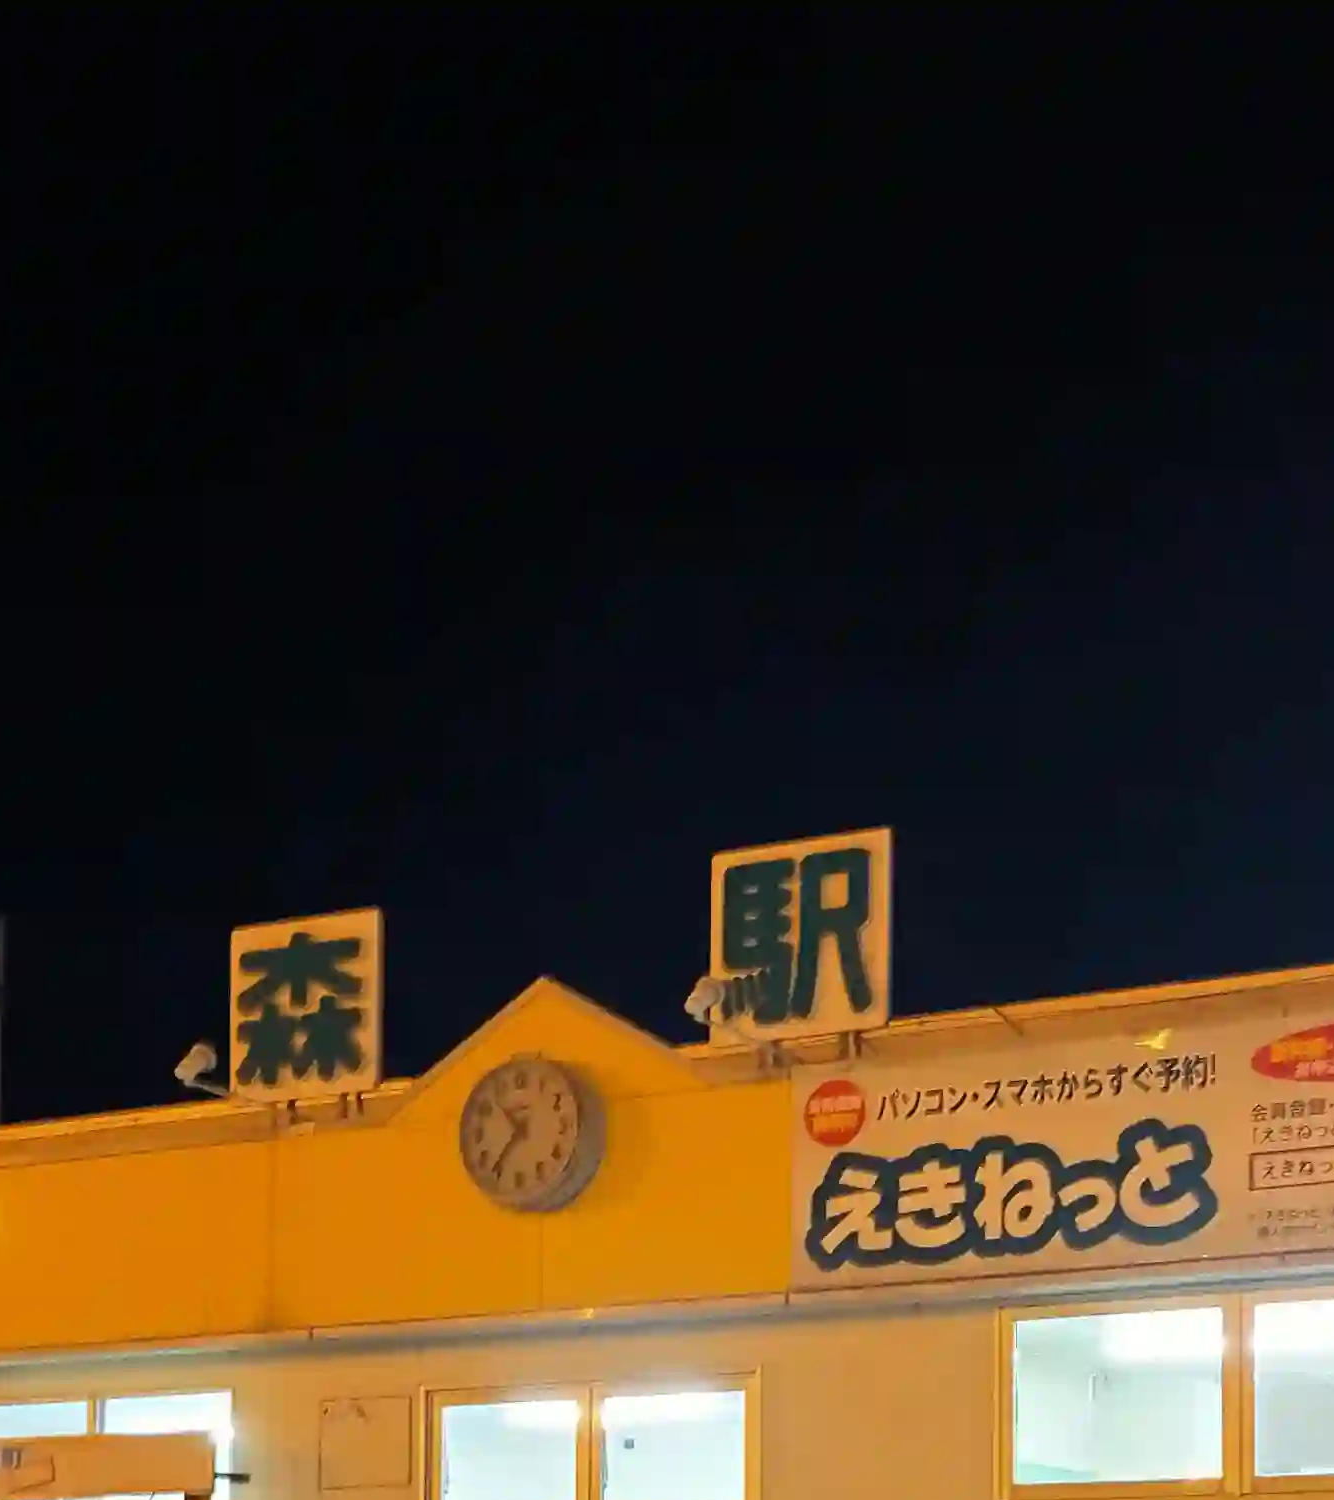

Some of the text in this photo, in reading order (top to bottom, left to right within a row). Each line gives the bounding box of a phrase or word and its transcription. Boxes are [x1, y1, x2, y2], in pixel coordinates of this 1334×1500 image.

[235, 846, 874, 1086] 森 駅
[876, 1053, 1216, 1121] パソコン・スマホからすぐ予約!
[807, 1121, 1215, 1268] えきねっと
